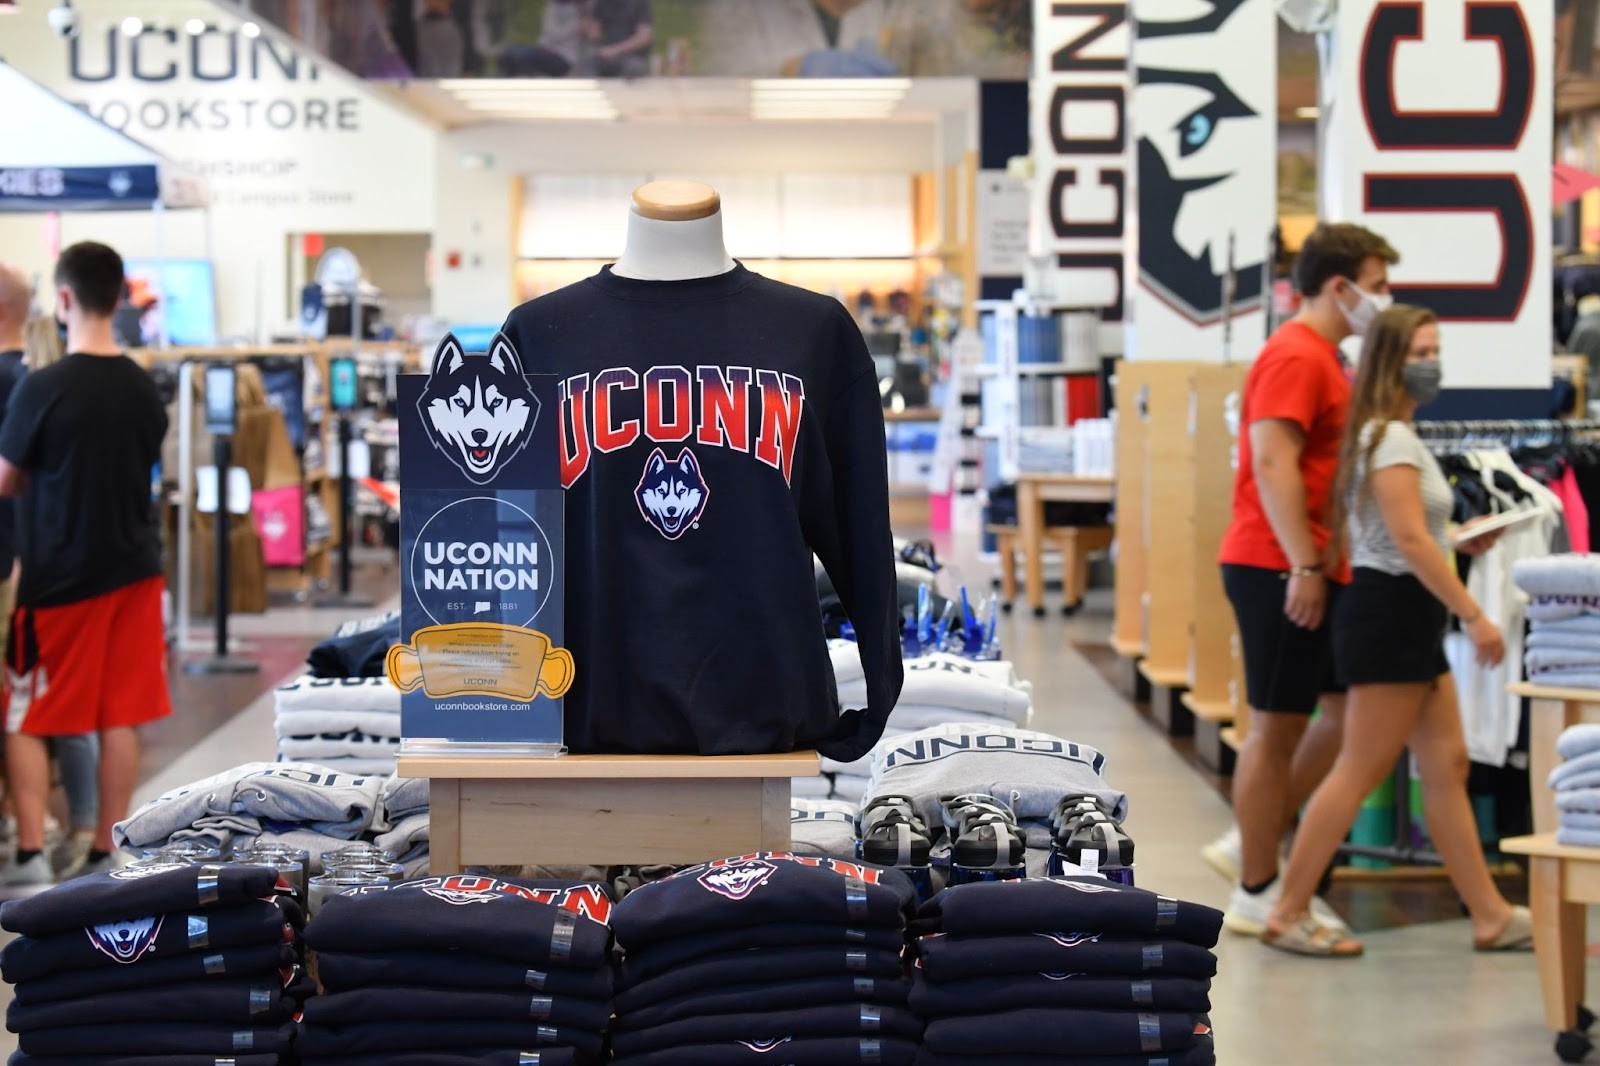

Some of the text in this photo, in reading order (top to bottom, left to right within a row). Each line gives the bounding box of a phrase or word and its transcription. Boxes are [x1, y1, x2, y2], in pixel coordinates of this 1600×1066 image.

[69, 23, 318, 83] UCON
[557, 364, 806, 490] UCONN
[424, 541, 538, 565] UCONN
[424, 568, 539, 591] NATION
[447, 602, 518, 610] EST. 1881
[463, 678, 498, 686] UCONN
[434, 702, 530, 711] uconnbookstore.com
